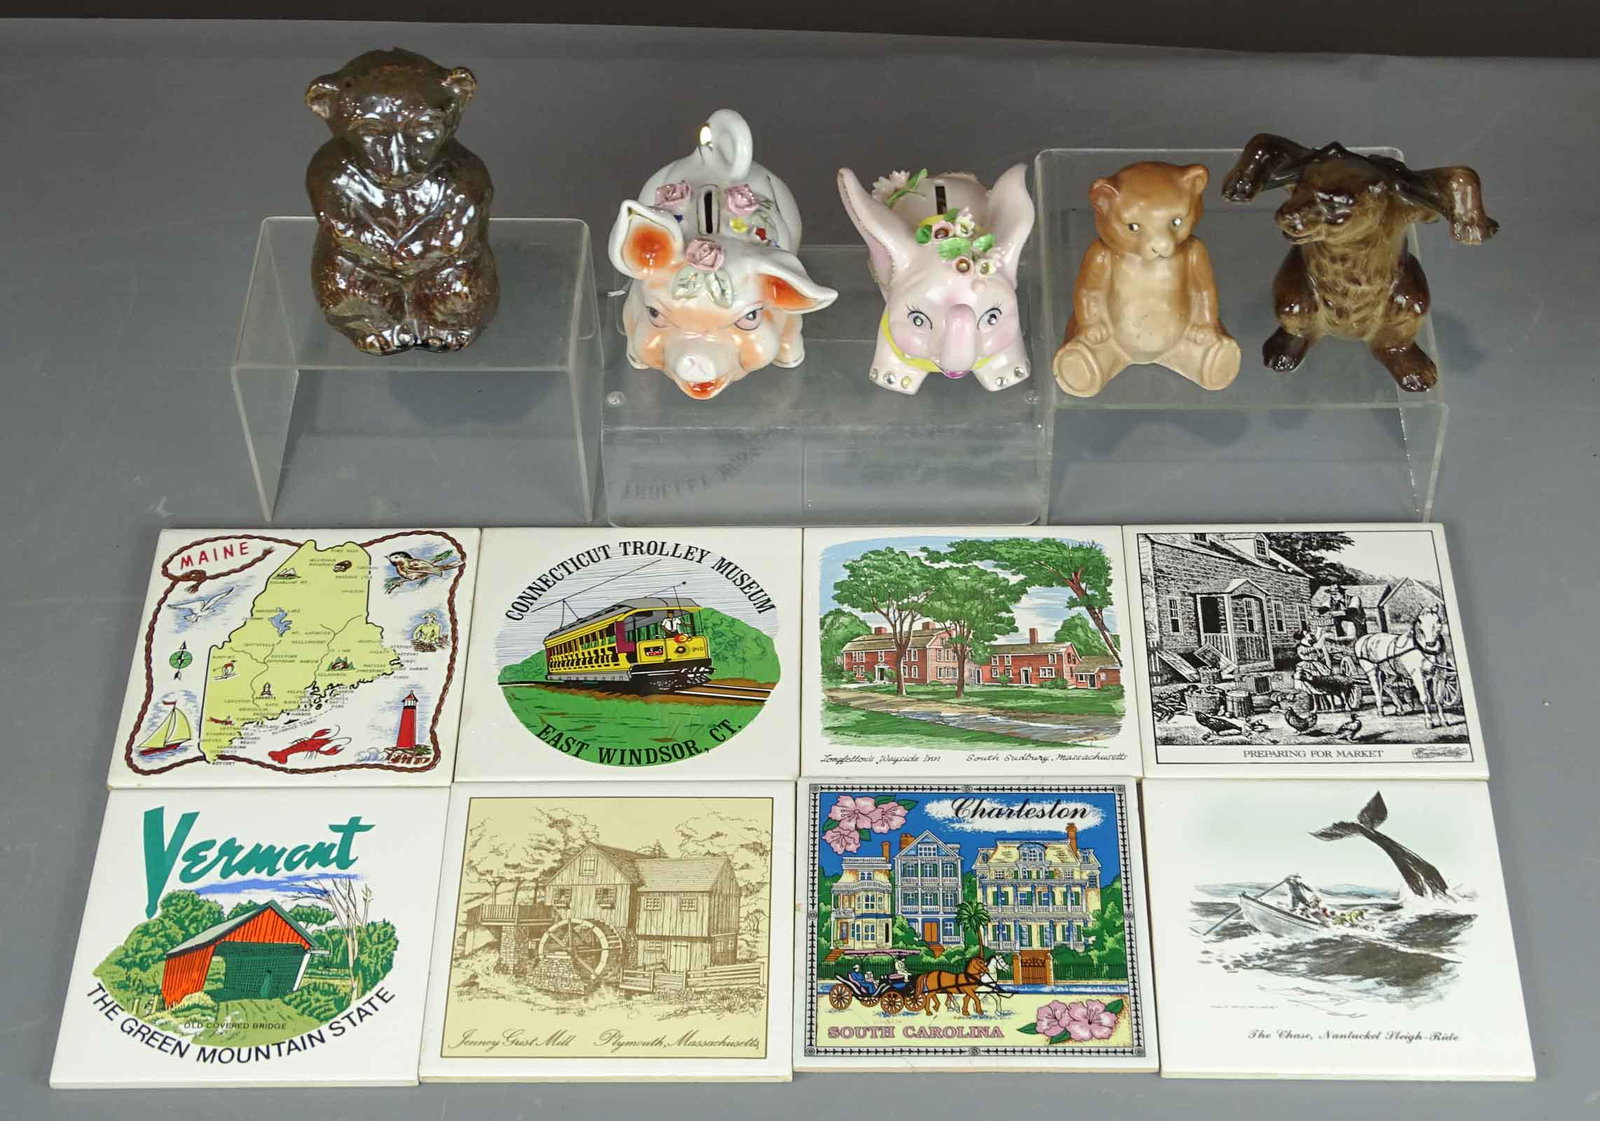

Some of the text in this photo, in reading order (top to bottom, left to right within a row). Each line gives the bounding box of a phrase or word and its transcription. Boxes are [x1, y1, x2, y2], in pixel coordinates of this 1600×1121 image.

[180, 542, 250, 570] MAINE
[504, 540, 776, 622] CONNECTICUT TROLLEY MUSEUM
[535, 718, 742, 766] EAST WINDSOR, CT.
[876, 753, 920, 766] Wayside
[923, 753, 942, 763] Inn
[965, 753, 1000, 762] South
[1055, 751, 1128, 762] Massachusetts
[1243, 749, 1384, 759] PREPARING FOR MARKET
[951, 795, 1090, 820] Charleston
[143, 806, 376, 919] Vermont
[86, 982, 397, 1065] THE GREEN MOUNTAIN STATE
[184, 1020, 287, 1030] OLD COVERED BRIDGE
[827, 1025, 1006, 1039] SOUTH CAROLINA
[501, 1028, 538, 1047] Grist
[535, 1028, 577, 1047] Mill
[593, 1028, 760, 1053] Plymouth, Massachusetts
[1247, 1029, 1271, 1040] The
[1317, 1029, 1382, 1041] Nantucket
